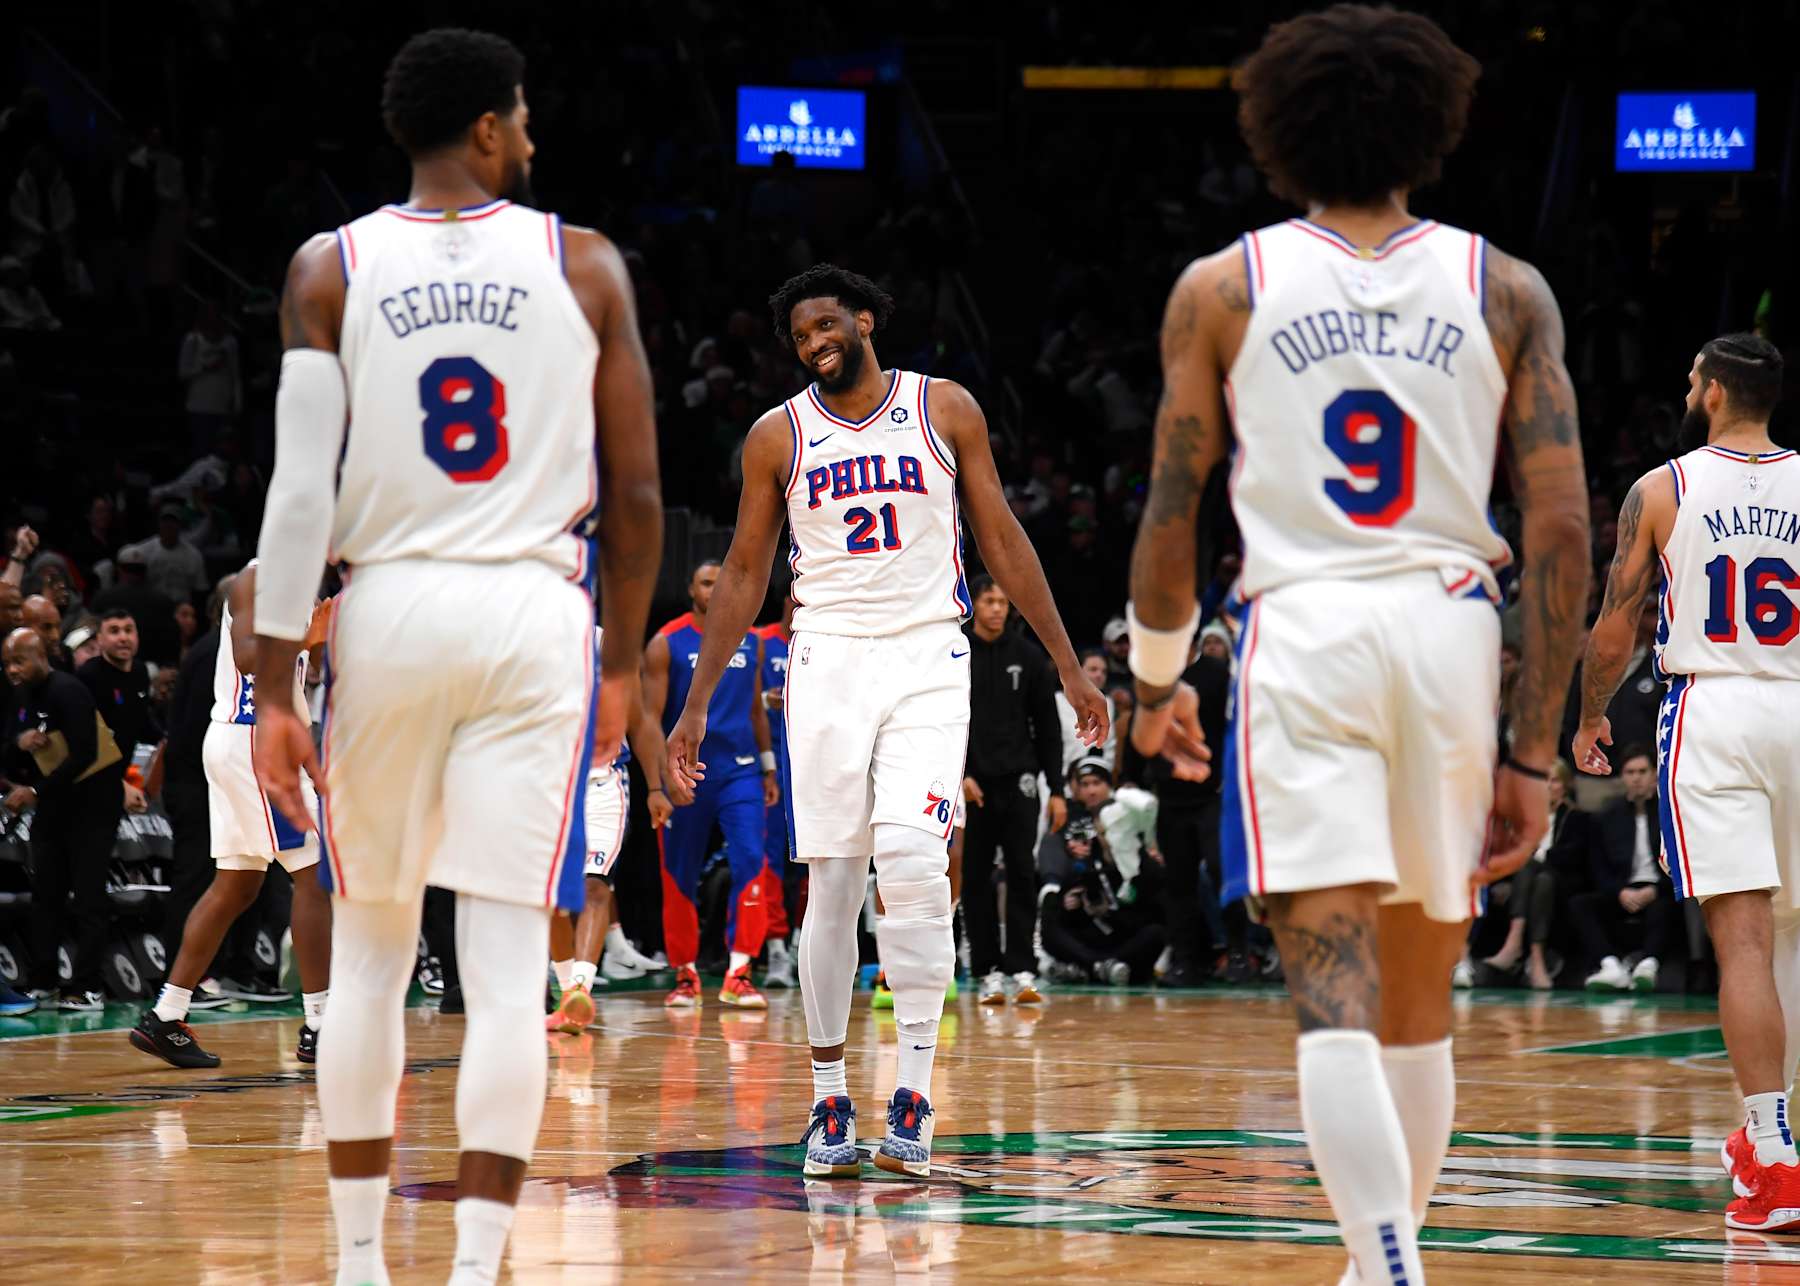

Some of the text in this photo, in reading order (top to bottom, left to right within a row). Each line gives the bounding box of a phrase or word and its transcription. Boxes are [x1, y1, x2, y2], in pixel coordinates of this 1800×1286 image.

[744, 123, 856, 147] ARBELLA
[1624, 127, 1746, 148] ARBELLA
[379, 282, 529, 339] GEORGE
[1270, 309, 1464, 377] OUBRE JR
[418, 356, 510, 485] 8
[806, 454, 928, 510] PHILA
[1323, 389, 1418, 528] 9
[843, 502, 902, 554] 21
[1703, 506, 1800, 544] MARTIN
[1704, 555, 1800, 646] 16
[923, 791, 950, 823] 76
[586, 851, 605, 866] 76
